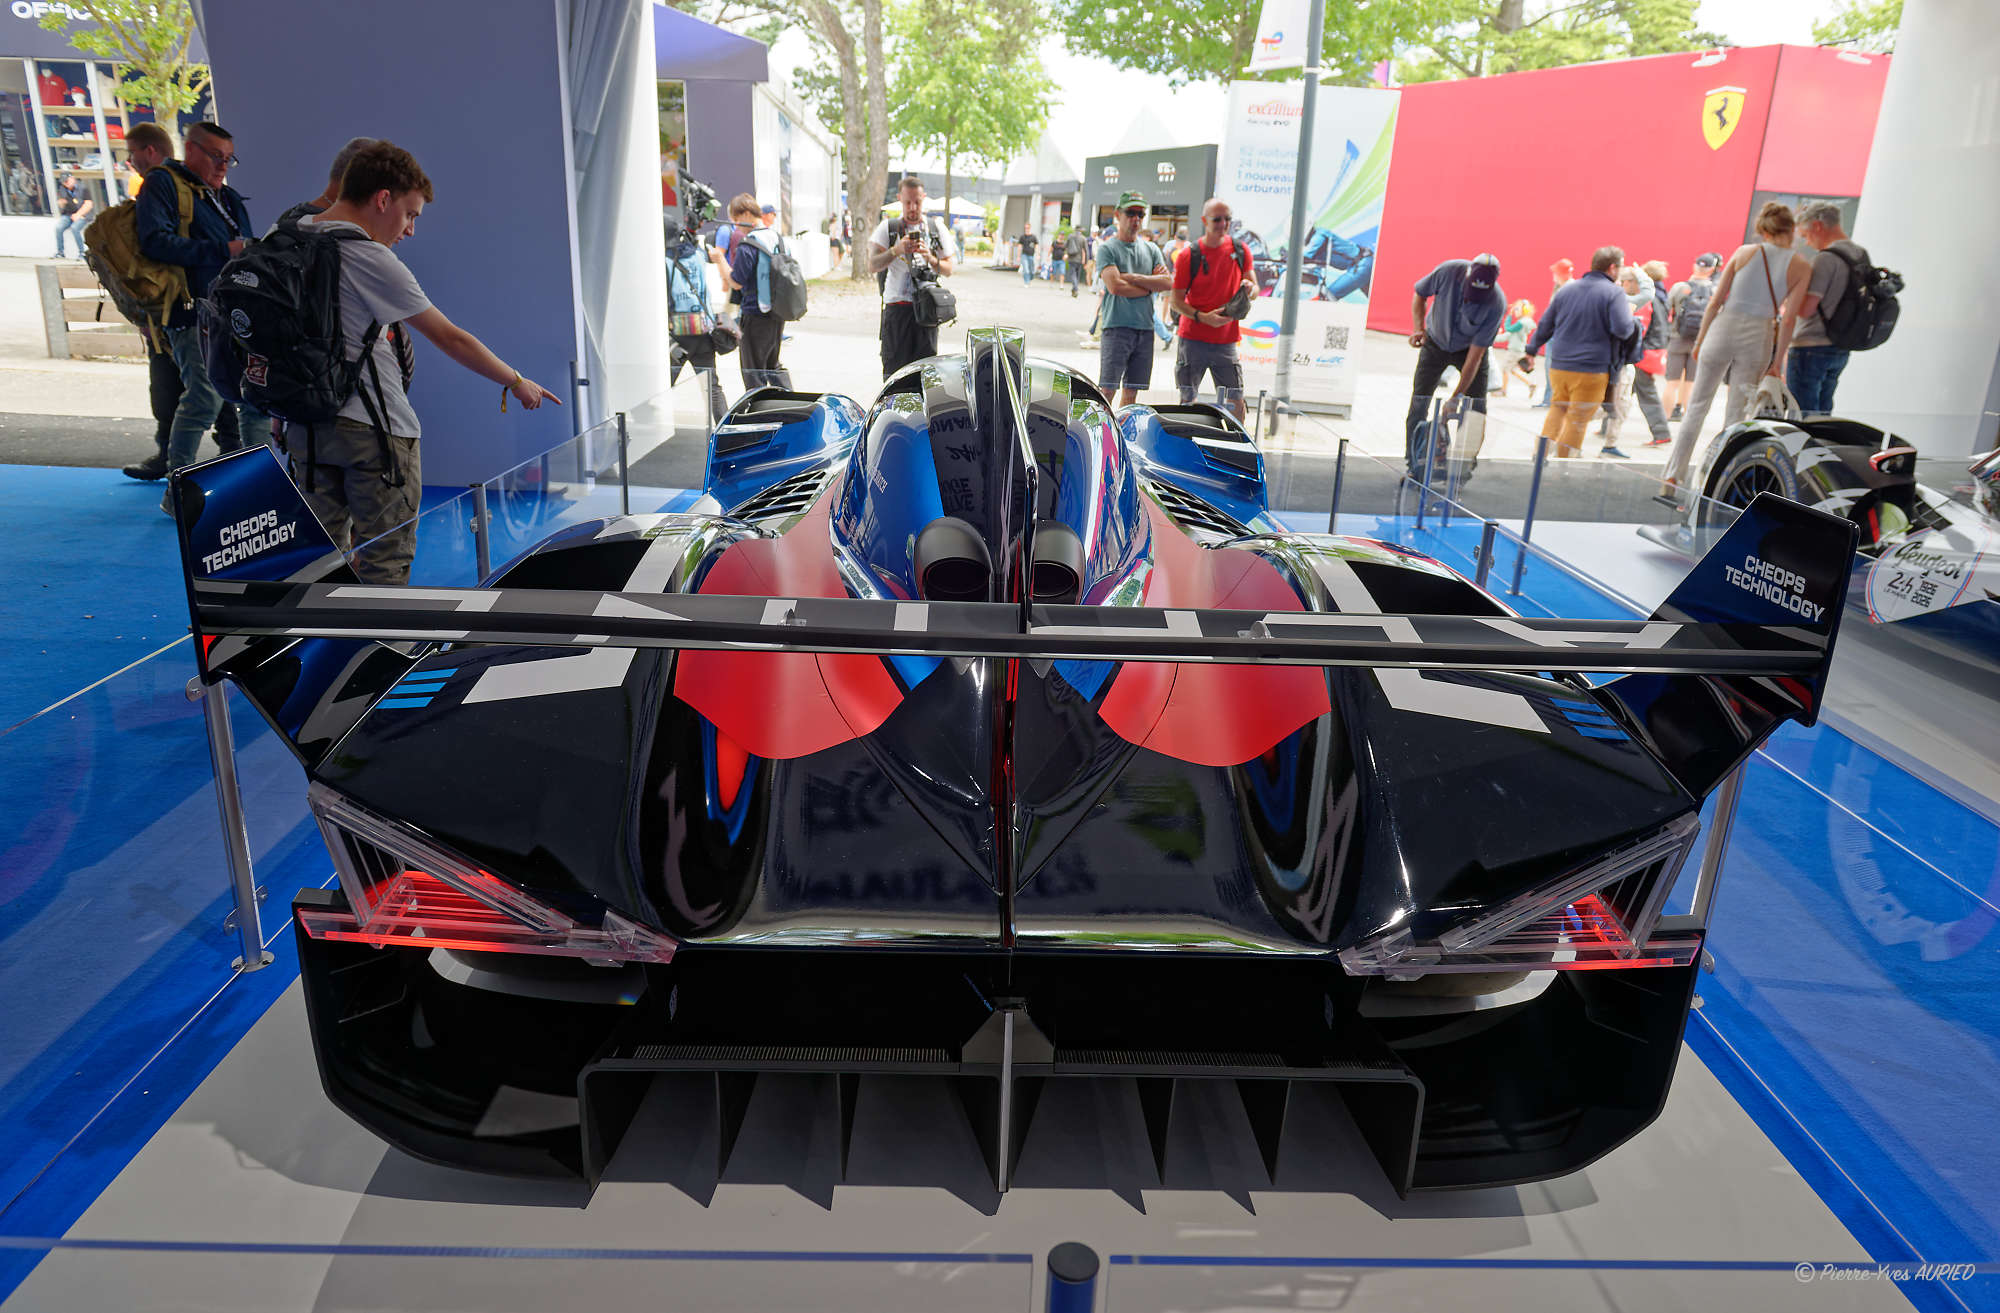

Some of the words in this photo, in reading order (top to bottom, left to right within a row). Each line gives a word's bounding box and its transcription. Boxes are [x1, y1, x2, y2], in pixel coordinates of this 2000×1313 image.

[1235, 183, 1292, 194] carburant
[219, 509, 278, 546] CHEOPS
[202, 521, 297, 574] TECHNOLOGY
[1725, 565, 1826, 622] TECHNOLOGY
[1744, 555, 1806, 594] CHEOPS
